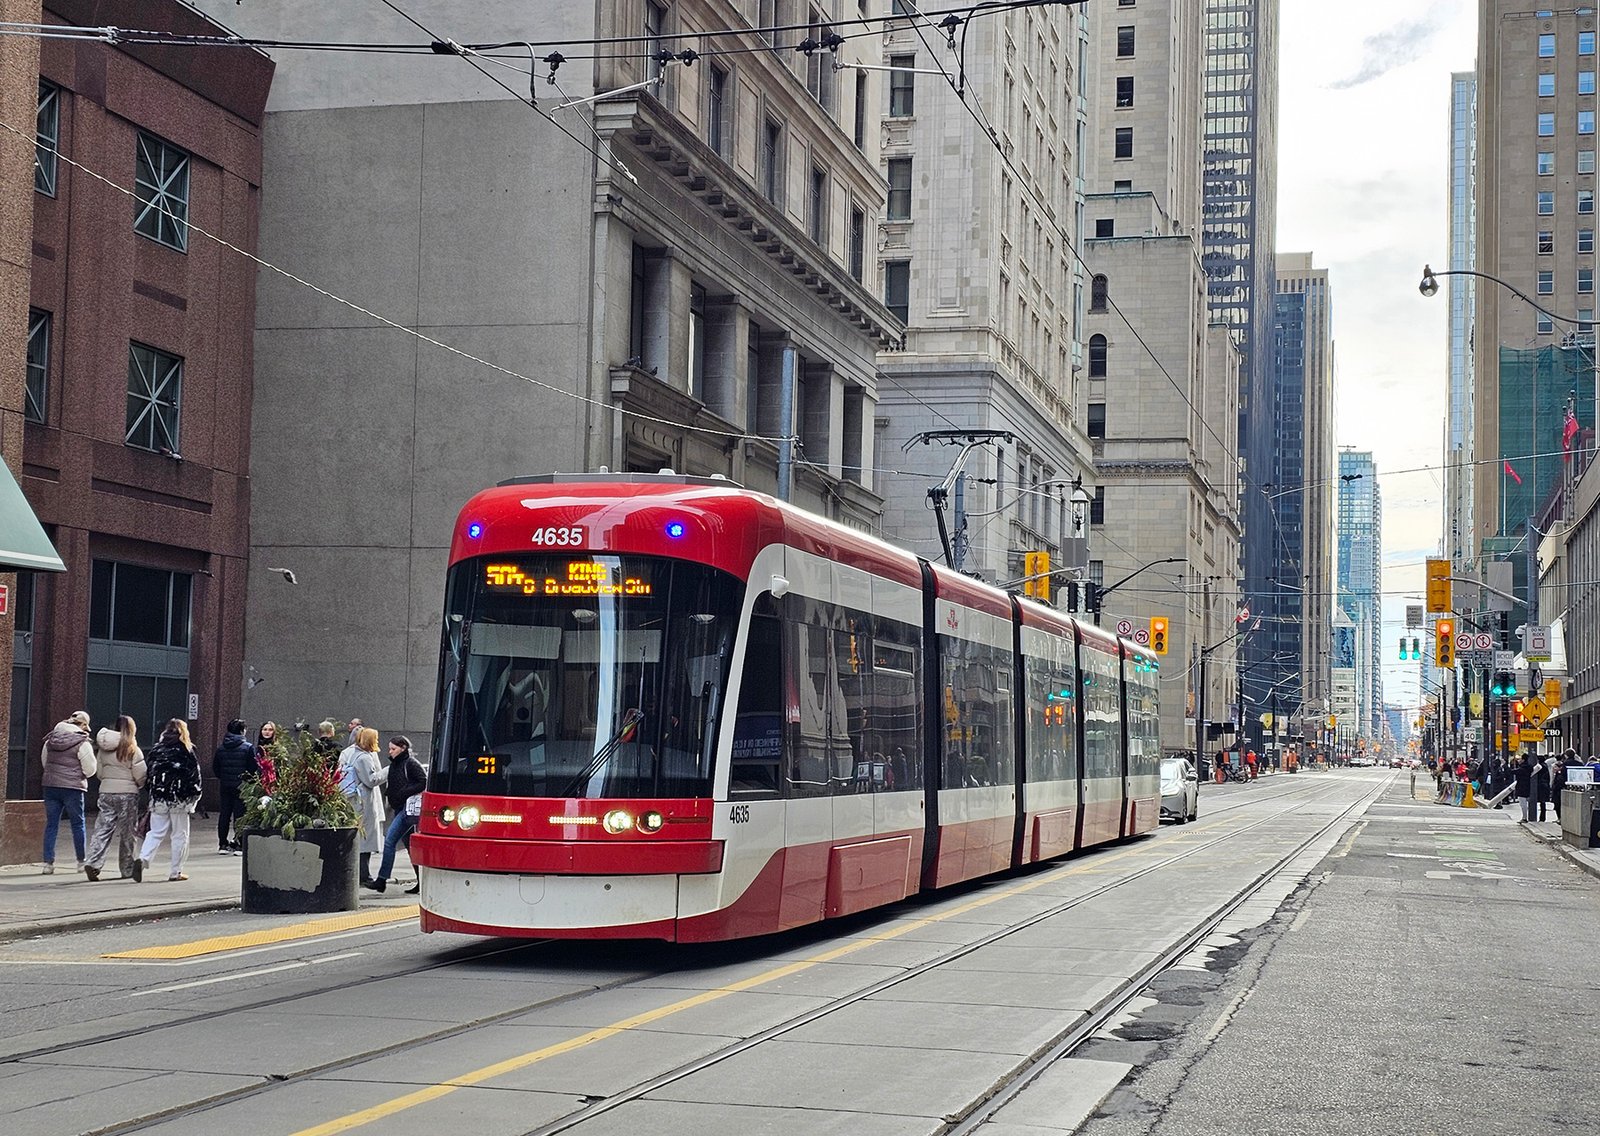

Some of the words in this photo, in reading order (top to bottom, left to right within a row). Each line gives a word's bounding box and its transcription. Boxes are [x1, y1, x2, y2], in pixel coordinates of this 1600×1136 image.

[531, 527, 583, 546] 4635
[1464, 732, 1475, 740] 40
[477, 756, 496, 774] 31
[729, 805, 750, 825] 4635
